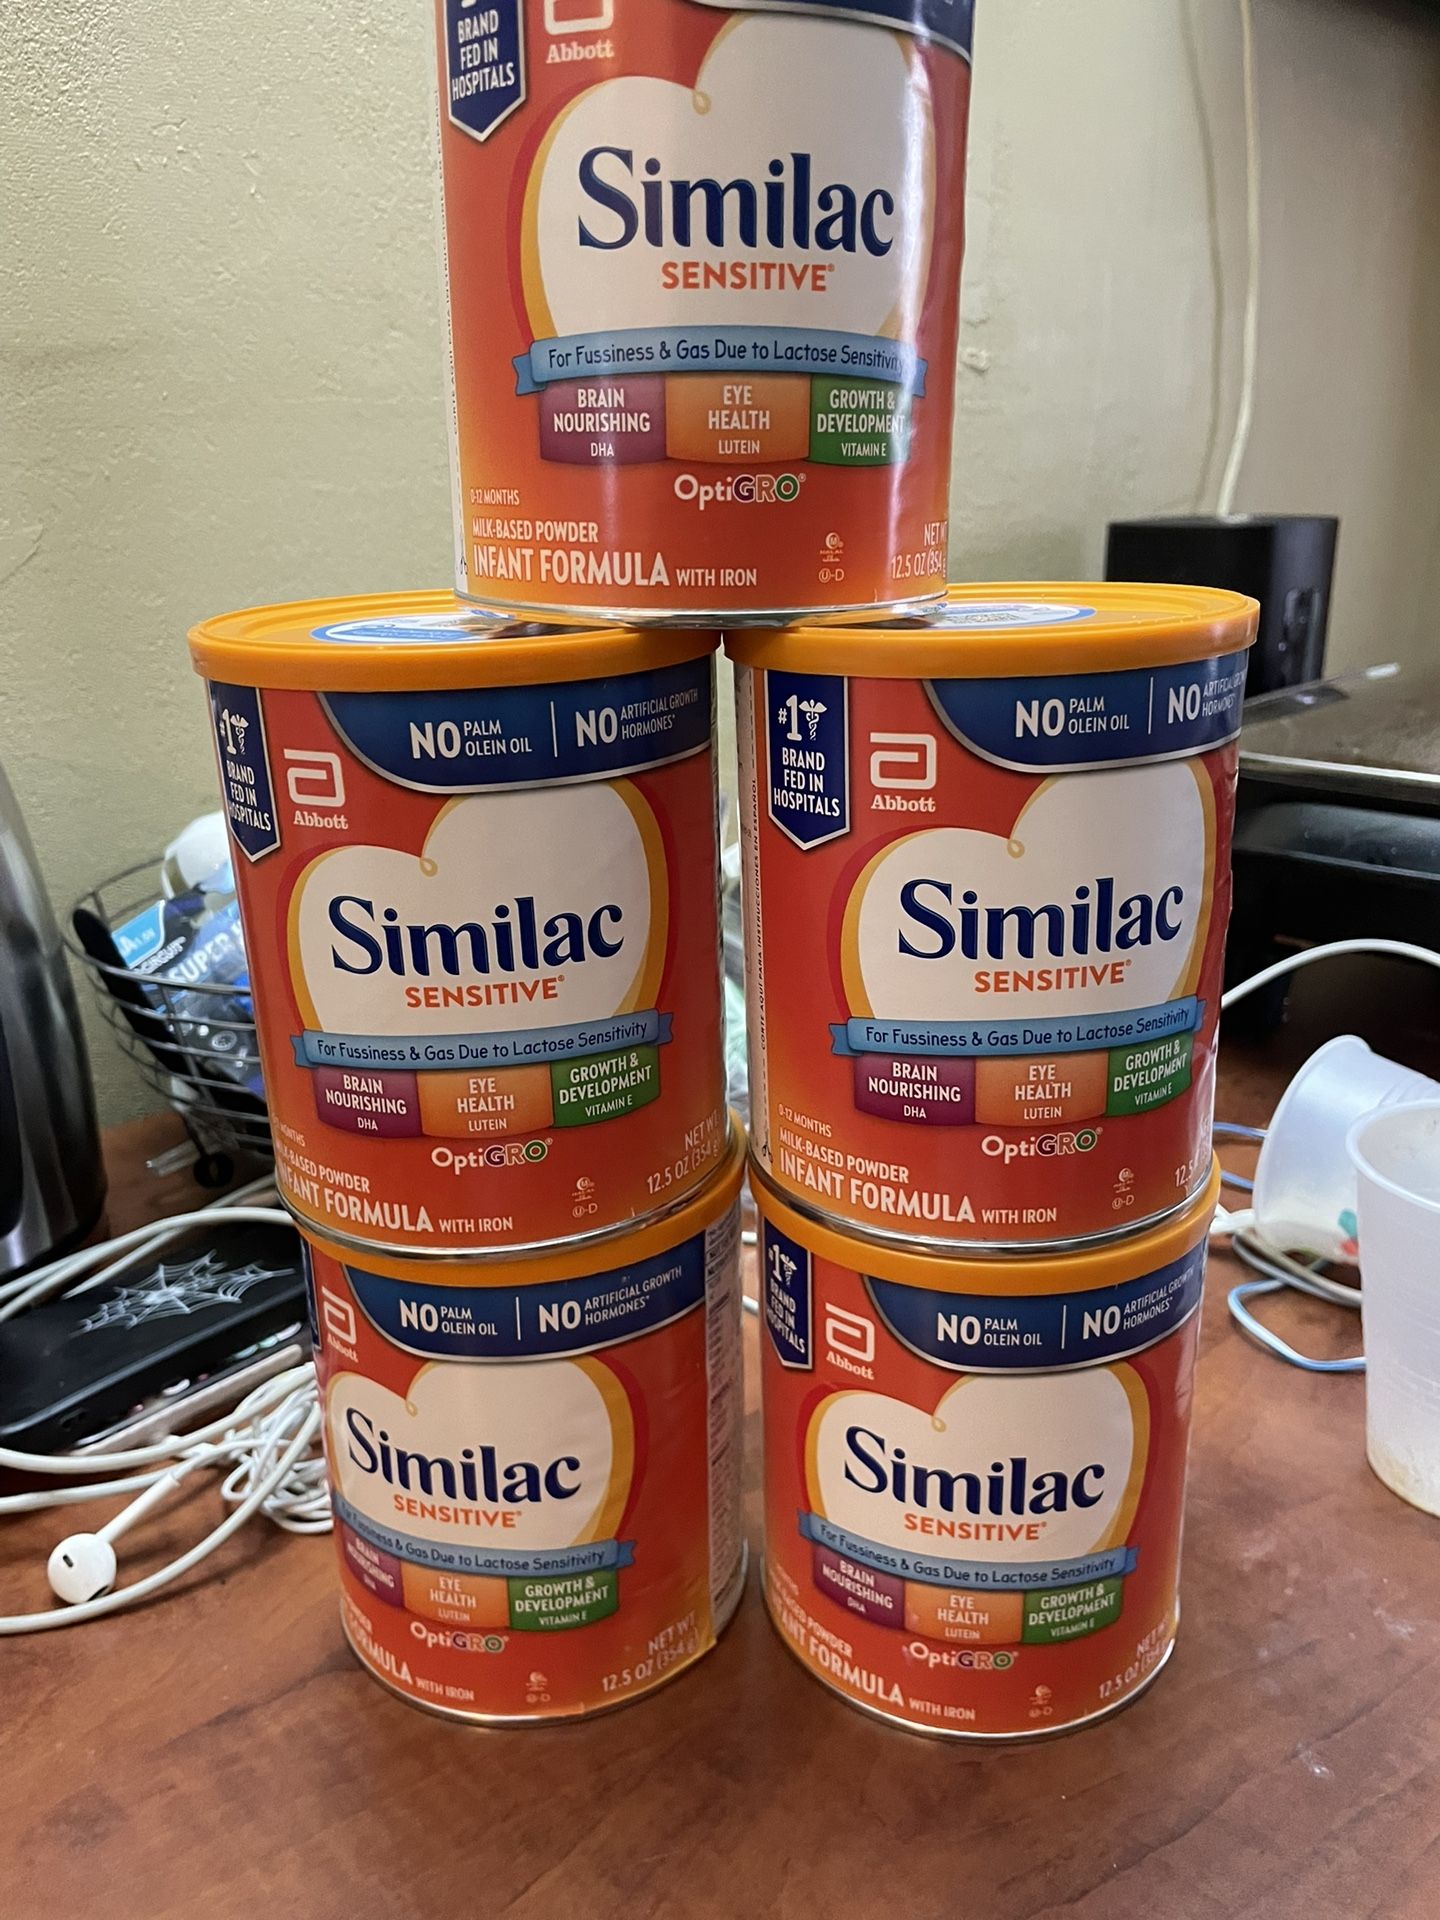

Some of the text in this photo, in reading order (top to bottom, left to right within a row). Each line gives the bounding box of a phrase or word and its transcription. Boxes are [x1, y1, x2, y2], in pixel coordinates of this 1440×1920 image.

[457, 9, 499, 43] BRAND
[460, 37, 498, 70] FED IN
[546, 39, 615, 64] Abbott
[452, 62, 514, 100] HOSPITALS
[578, 146, 894, 257] Similac
[548, 339, 837, 368] For Fussiness Gas Due to Lactose
[577, 387, 625, 408] BRAIN
[723, 385, 752, 406] EYE
[830, 389, 884, 409] GROWTH
[553, 412, 651, 433] NOURISHING
[708, 410, 770, 431] HEALTH
[817, 414, 904, 434] DEVELOPMENT
[590, 442, 614, 458] DHA
[718, 439, 760, 455] LUTEIN
[841, 442, 878, 458] VITAMIN
[483, 489, 520, 506] MONTHS
[472, 518, 598, 543] MILK-BASED POWDER
[924, 523, 940, 546] NET
[473, 545, 757, 587] INFANT FORMULA WITH IRON
[891, 553, 925, 579] 12.5 OZ
[620, 688, 698, 721] ARTIFICIAL GROWTH
[1069, 696, 1105, 714] PALM
[1168, 683, 1201, 724] NO
[463, 719, 502, 736] PALM
[575, 706, 618, 747] NO
[1015, 698, 1066, 738] NO
[1068, 714, 1130, 735] OLEIN OIL
[409, 721, 461, 759] NO
[465, 737, 532, 757] OLEIN OIL
[781, 747, 826, 773] BRAND
[783, 768, 824, 794] FED IN
[230, 782, 257, 807] FED IN
[773, 787, 840, 818] HOSPITALS
[871, 794, 936, 813] Abbott
[292, 810, 348, 831] Abbott
[898, 876, 1184, 960] Similac
[328, 895, 625, 976] Similac
[865, 1006, 1190, 1047] For Fussiness Gas Due to Lactose Sensitivity
[317, 1020, 648, 1062] For Fussiness Gas Due to Lactose Sensitivity
[1125, 1045, 1171, 1071] GROWTH
[569, 1059, 627, 1084] GROWTH
[892, 1062, 938, 1082] BRAIN
[1029, 1064, 1056, 1082] EYE
[1114, 1055, 1187, 1093] DEVELOPMENT
[343, 1074, 384, 1095] BRAIN
[469, 1076, 497, 1095] EYE
[559, 1064, 652, 1105] DEVELOPMENT
[868, 1078, 961, 1103] NOURISHING
[1015, 1080, 1072, 1100] HEALTH
[1134, 1086, 1167, 1107] VITAMIN
[325, 1088, 407, 1115] NOURISHING
[457, 1094, 515, 1114] HEALTH
[585, 1096, 625, 1118] VITAMIN
[903, 1104, 927, 1120] DHA
[1023, 1105, 1063, 1120] LUTEIN
[357, 1116, 379, 1131] DHA
[468, 1117, 507, 1132] LUTEIN
[684, 1121, 704, 1150] NET
[793, 1112, 832, 1138] MONTHS
[779, 1127, 909, 1184] MILK-BASED POWDER
[319, 1164, 370, 1194] POWDER
[646, 1156, 689, 1195] 12.5 OZ
[780, 1148, 1057, 1224] INFANT FORMULA WITH IRON
[324, 1188, 513, 1234] FORMULA WITH IRON
[585, 1265, 682, 1312] ARTIFICIAL GROWTH
[1123, 1284, 1168, 1314] ARTIFICIAL
[399, 1299, 438, 1333] NO
[441, 1305, 473, 1320] PALM
[538, 1300, 581, 1333] NO
[984, 1317, 1019, 1331] PALM
[1082, 1305, 1121, 1341] NO
[441, 1320, 498, 1336] OLEIN OIL
[937, 1312, 980, 1346] NO
[983, 1331, 1042, 1347] OLEIN OIL
[826, 1350, 875, 1380] Abbott
[346, 1407, 582, 1504] Similac
[844, 1425, 1105, 1517] Similac
[405, 1543, 606, 1571] Gas Due to Lactose Sensitivity
[839, 1531, 1116, 1583] Fussiness Gas Due to Lactose Sensitivity
[430, 1589, 477, 1608] HEALTH
[515, 1585, 609, 1613] DEVELOPMENT
[525, 1580, 582, 1598] GROWTH
[950, 1594, 975, 1609] EYE
[1041, 1588, 1094, 1609] GROWTH
[937, 1608, 989, 1625] HEALTH
[1028, 1592, 1116, 1626] DEVELOPMENT
[416, 1679, 444, 1696] WITH
[602, 1670, 631, 1692] 12.5
[808, 1635, 976, 1721] FORMULA WITH IRON
